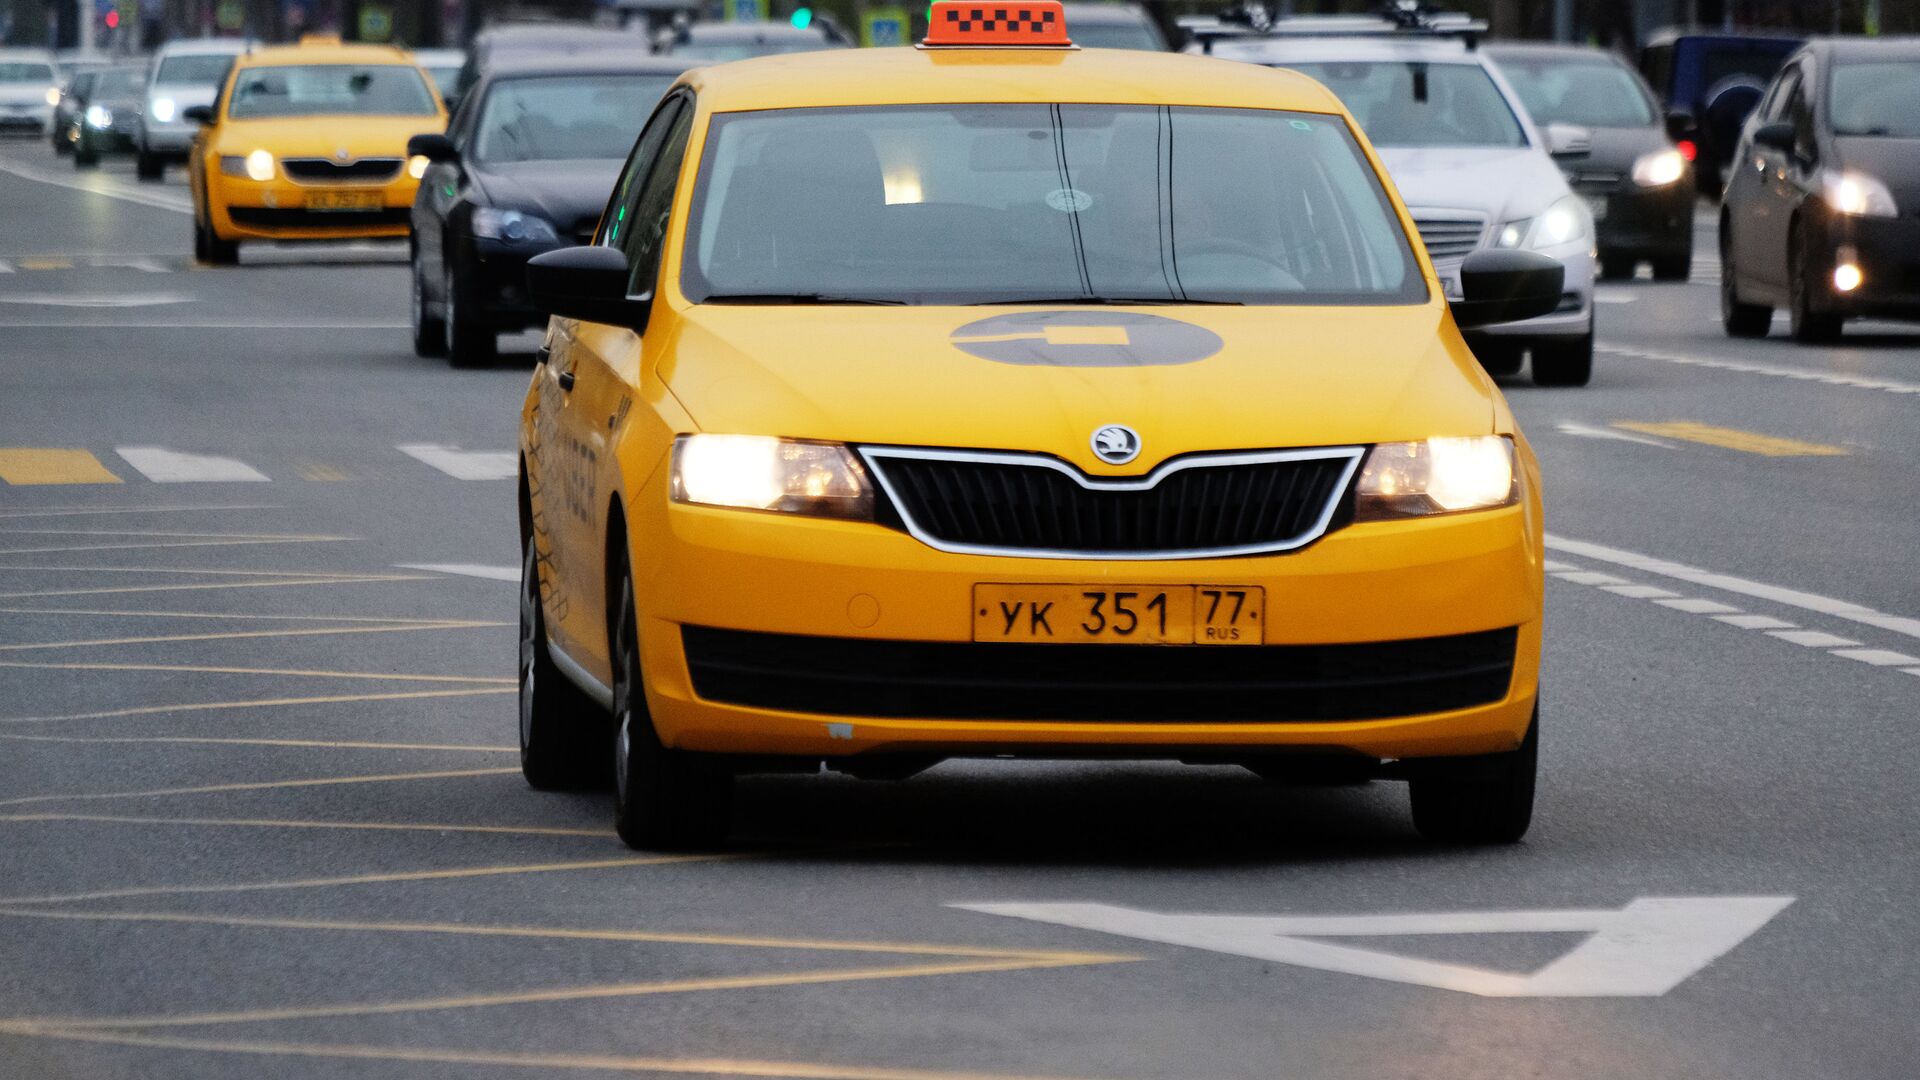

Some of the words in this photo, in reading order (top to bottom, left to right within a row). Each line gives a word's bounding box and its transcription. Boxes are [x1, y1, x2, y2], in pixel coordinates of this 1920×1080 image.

[1082, 592, 1168, 635] 351
[1202, 591, 1246, 624] 77
[1206, 627, 1240, 640] RUS
